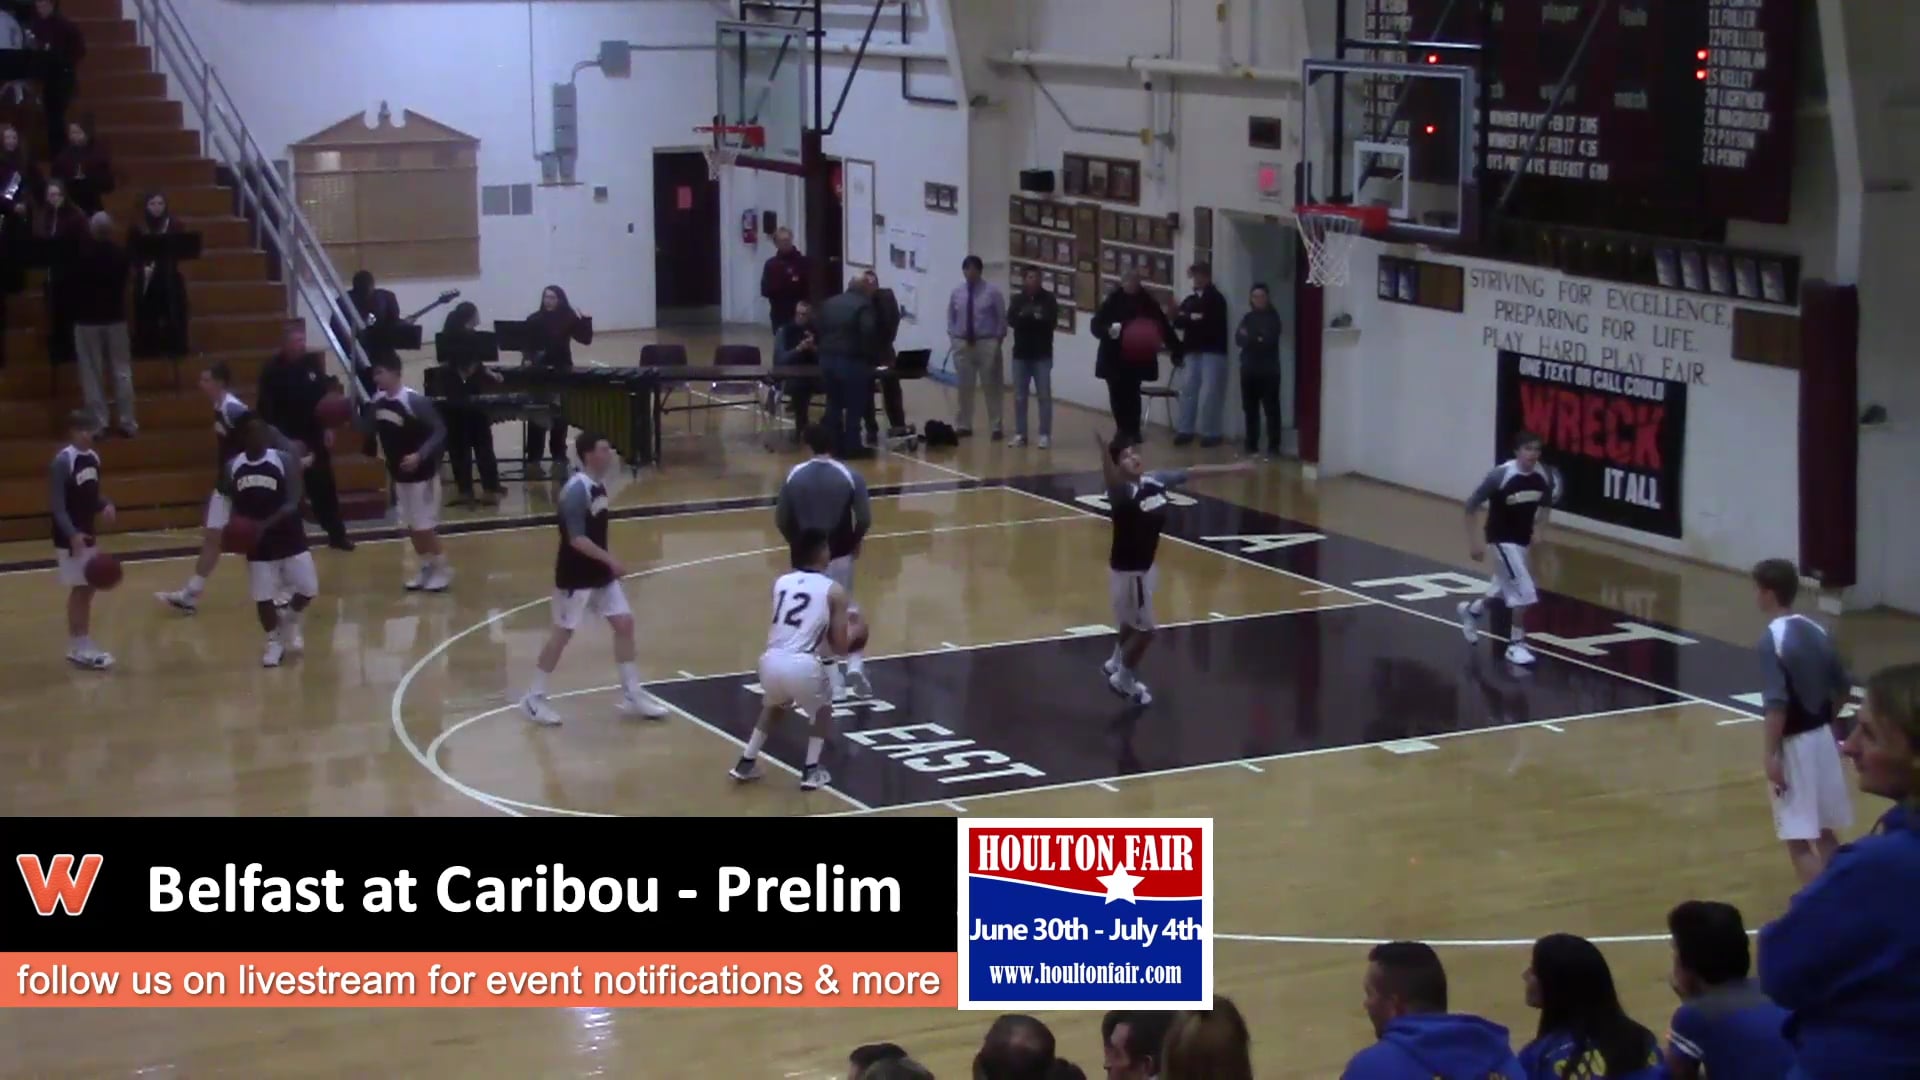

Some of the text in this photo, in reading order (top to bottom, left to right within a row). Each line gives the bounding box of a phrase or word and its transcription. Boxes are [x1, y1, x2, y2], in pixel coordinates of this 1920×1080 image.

[1471, 268, 1731, 330] STRIVING FOR EXCELLENCE,
[1483, 326, 1525, 352] PLAY
[1602, 346, 1647, 376] PLAY
[1495, 300, 1699, 353] PREPARING FOR LIFE.
[1519, 356, 1665, 401] ONE TEXT OR CALL COULD
[1520, 379, 1665, 470] WRECK
[1603, 466, 1662, 510] IT ALL
[772, 590, 812, 627] 12
[843, 722, 1046, 784] EAST
